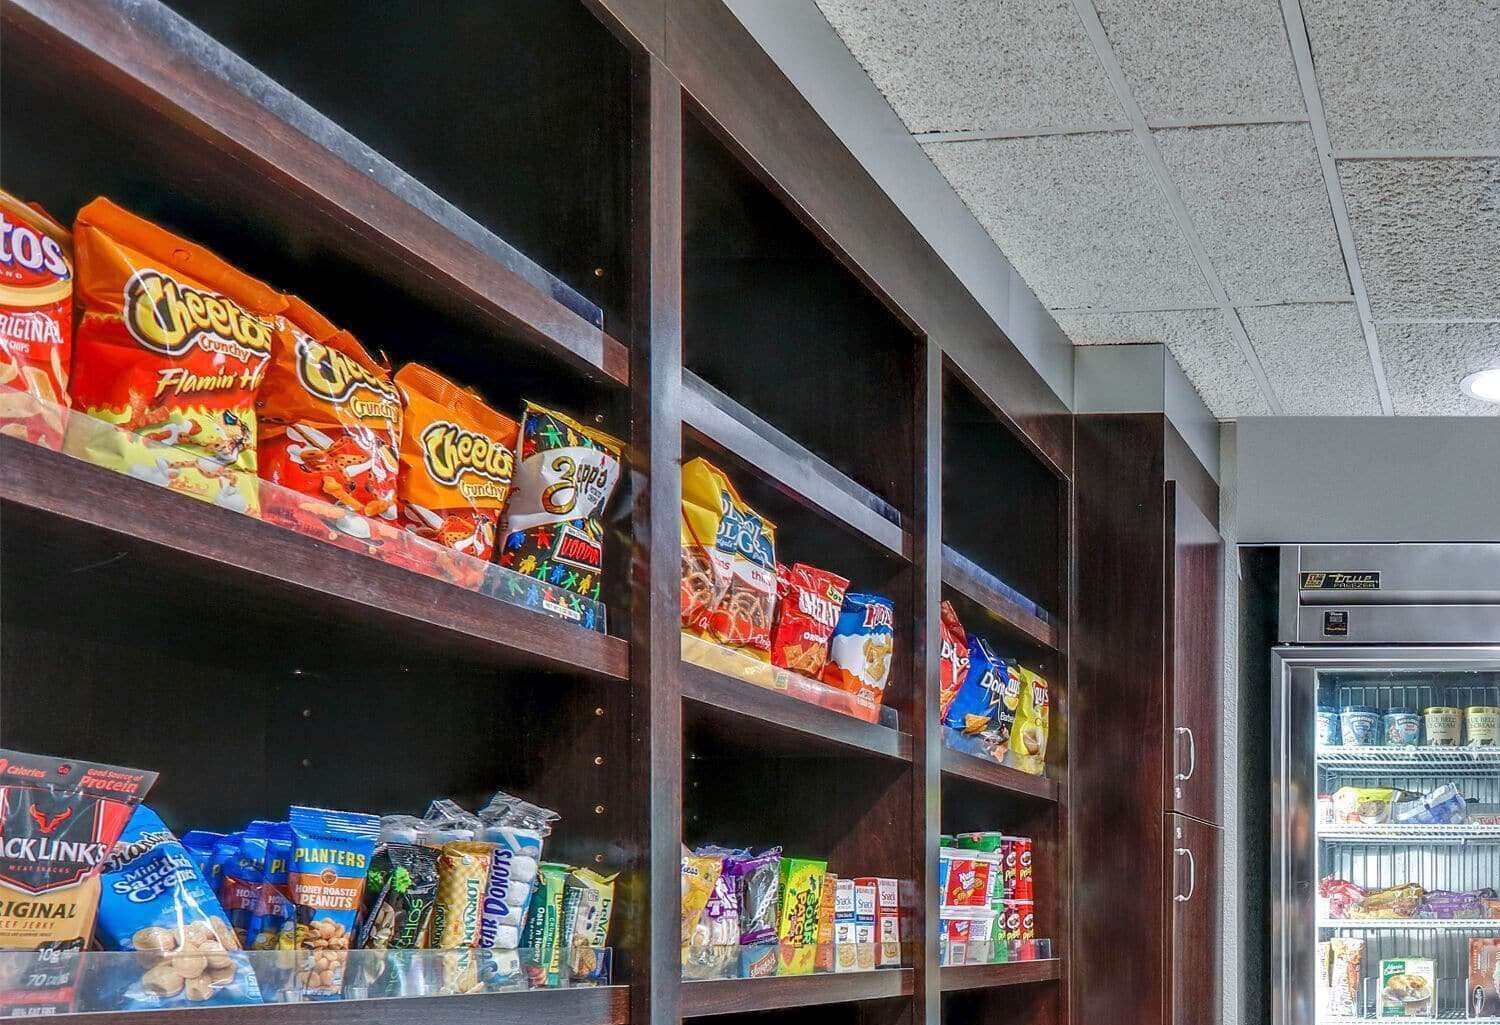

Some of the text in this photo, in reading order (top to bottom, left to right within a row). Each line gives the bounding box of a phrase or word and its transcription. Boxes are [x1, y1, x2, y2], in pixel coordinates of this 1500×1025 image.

[199, 333, 250, 362] Crunchy
[81, 775, 138, 793] Protein
[295, 847, 365, 868] PLANTERS
[125, 858, 160, 882] Mini
[295, 884, 322, 895] HONEY
[483, 849, 512, 917] DONUTS
[0, 901, 76, 919] IGINAL
[301, 895, 353, 908] PEANUTS
